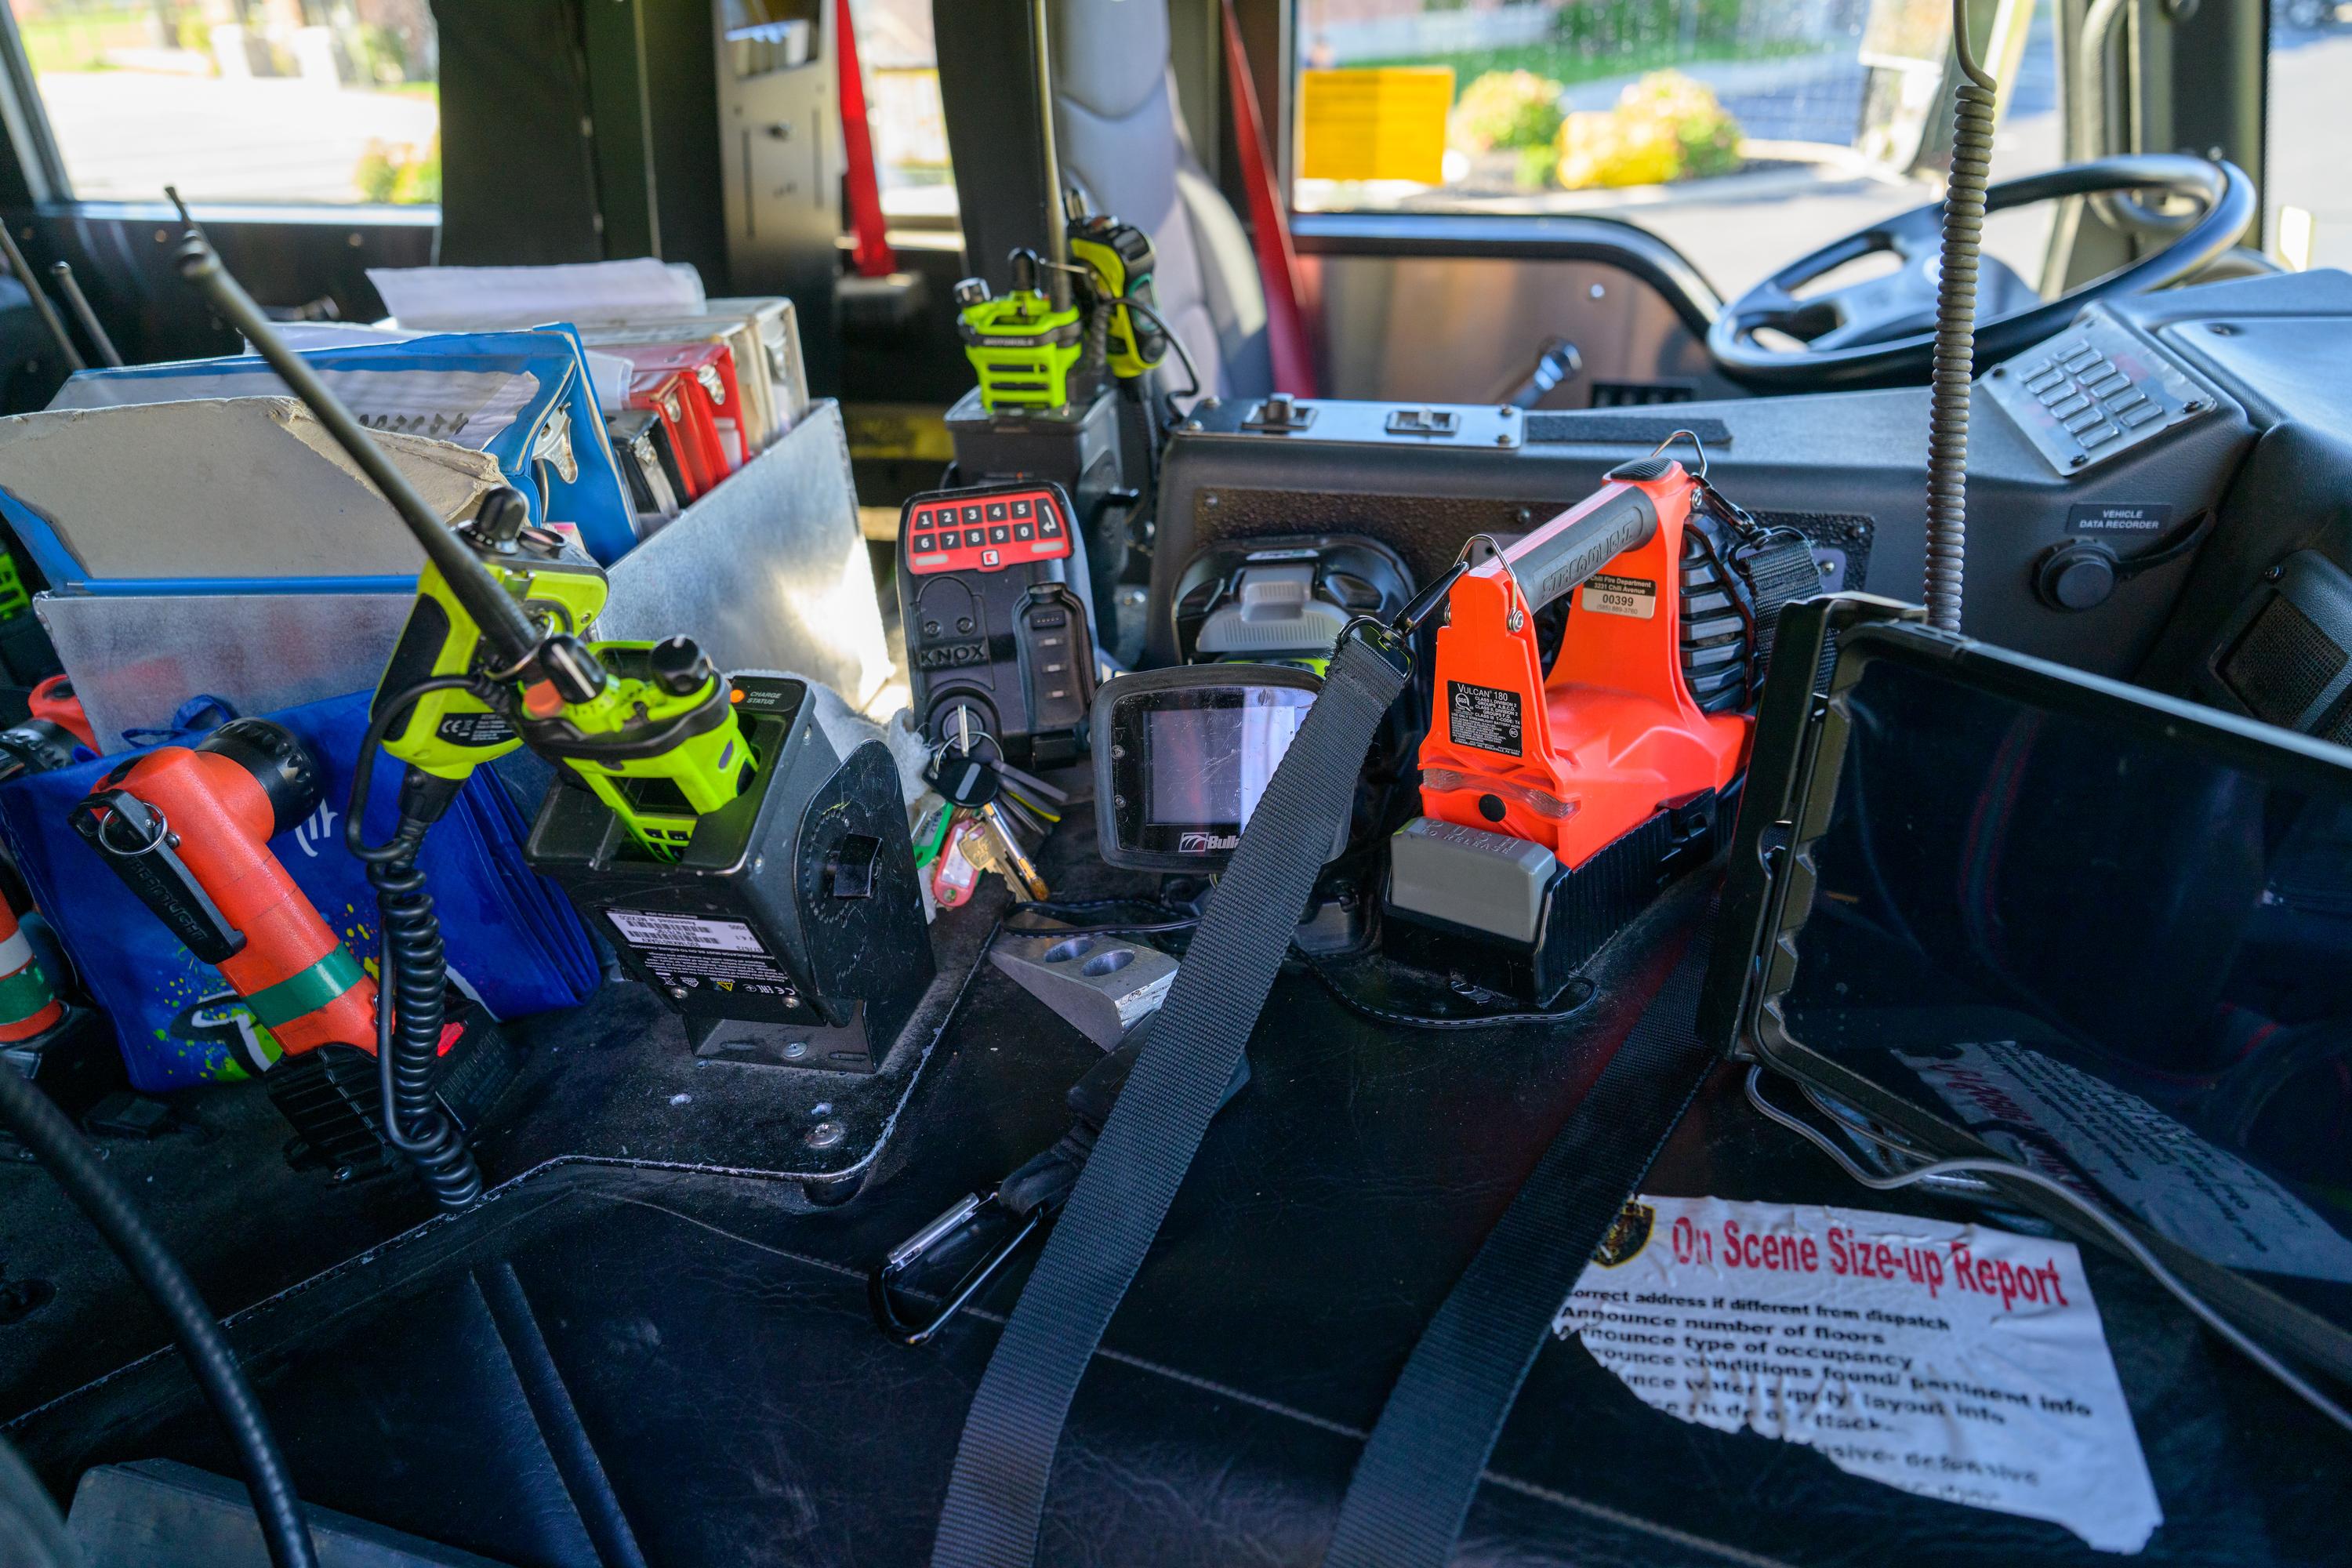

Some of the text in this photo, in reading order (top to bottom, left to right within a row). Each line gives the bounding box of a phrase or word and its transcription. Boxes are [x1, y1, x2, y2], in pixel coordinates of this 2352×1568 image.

[922, 505, 1025, 524] 1 2 3 4 5
[2103, 510, 2143, 518] VEHICLE
[921, 527, 1029, 547] 6 7 8 9 0
[1617, 578, 1651, 588] Department
[1602, 594, 1633, 606] 00399
[920, 644, 984, 663] KNOX
[1494, 691, 1508, 701] 180
[1207, 836, 1240, 849] Bull
[1427, 821, 1519, 849] PUSH
[1443, 834, 1512, 854] RELEASE
[1671, 1216, 2068, 1312] On Scene Size-up Report
[1570, 1289, 1950, 1330] orrect address if different from dispatch
[1561, 1306, 1886, 1345] Announce number of floors
[1685, 1336, 1736, 1352] type
[1745, 1341, 1768, 1353] of
[1776, 1345, 1912, 1370] occupancy
[1955, 1403, 2005, 1425] info
[2040, 1394, 2092, 1417] info
